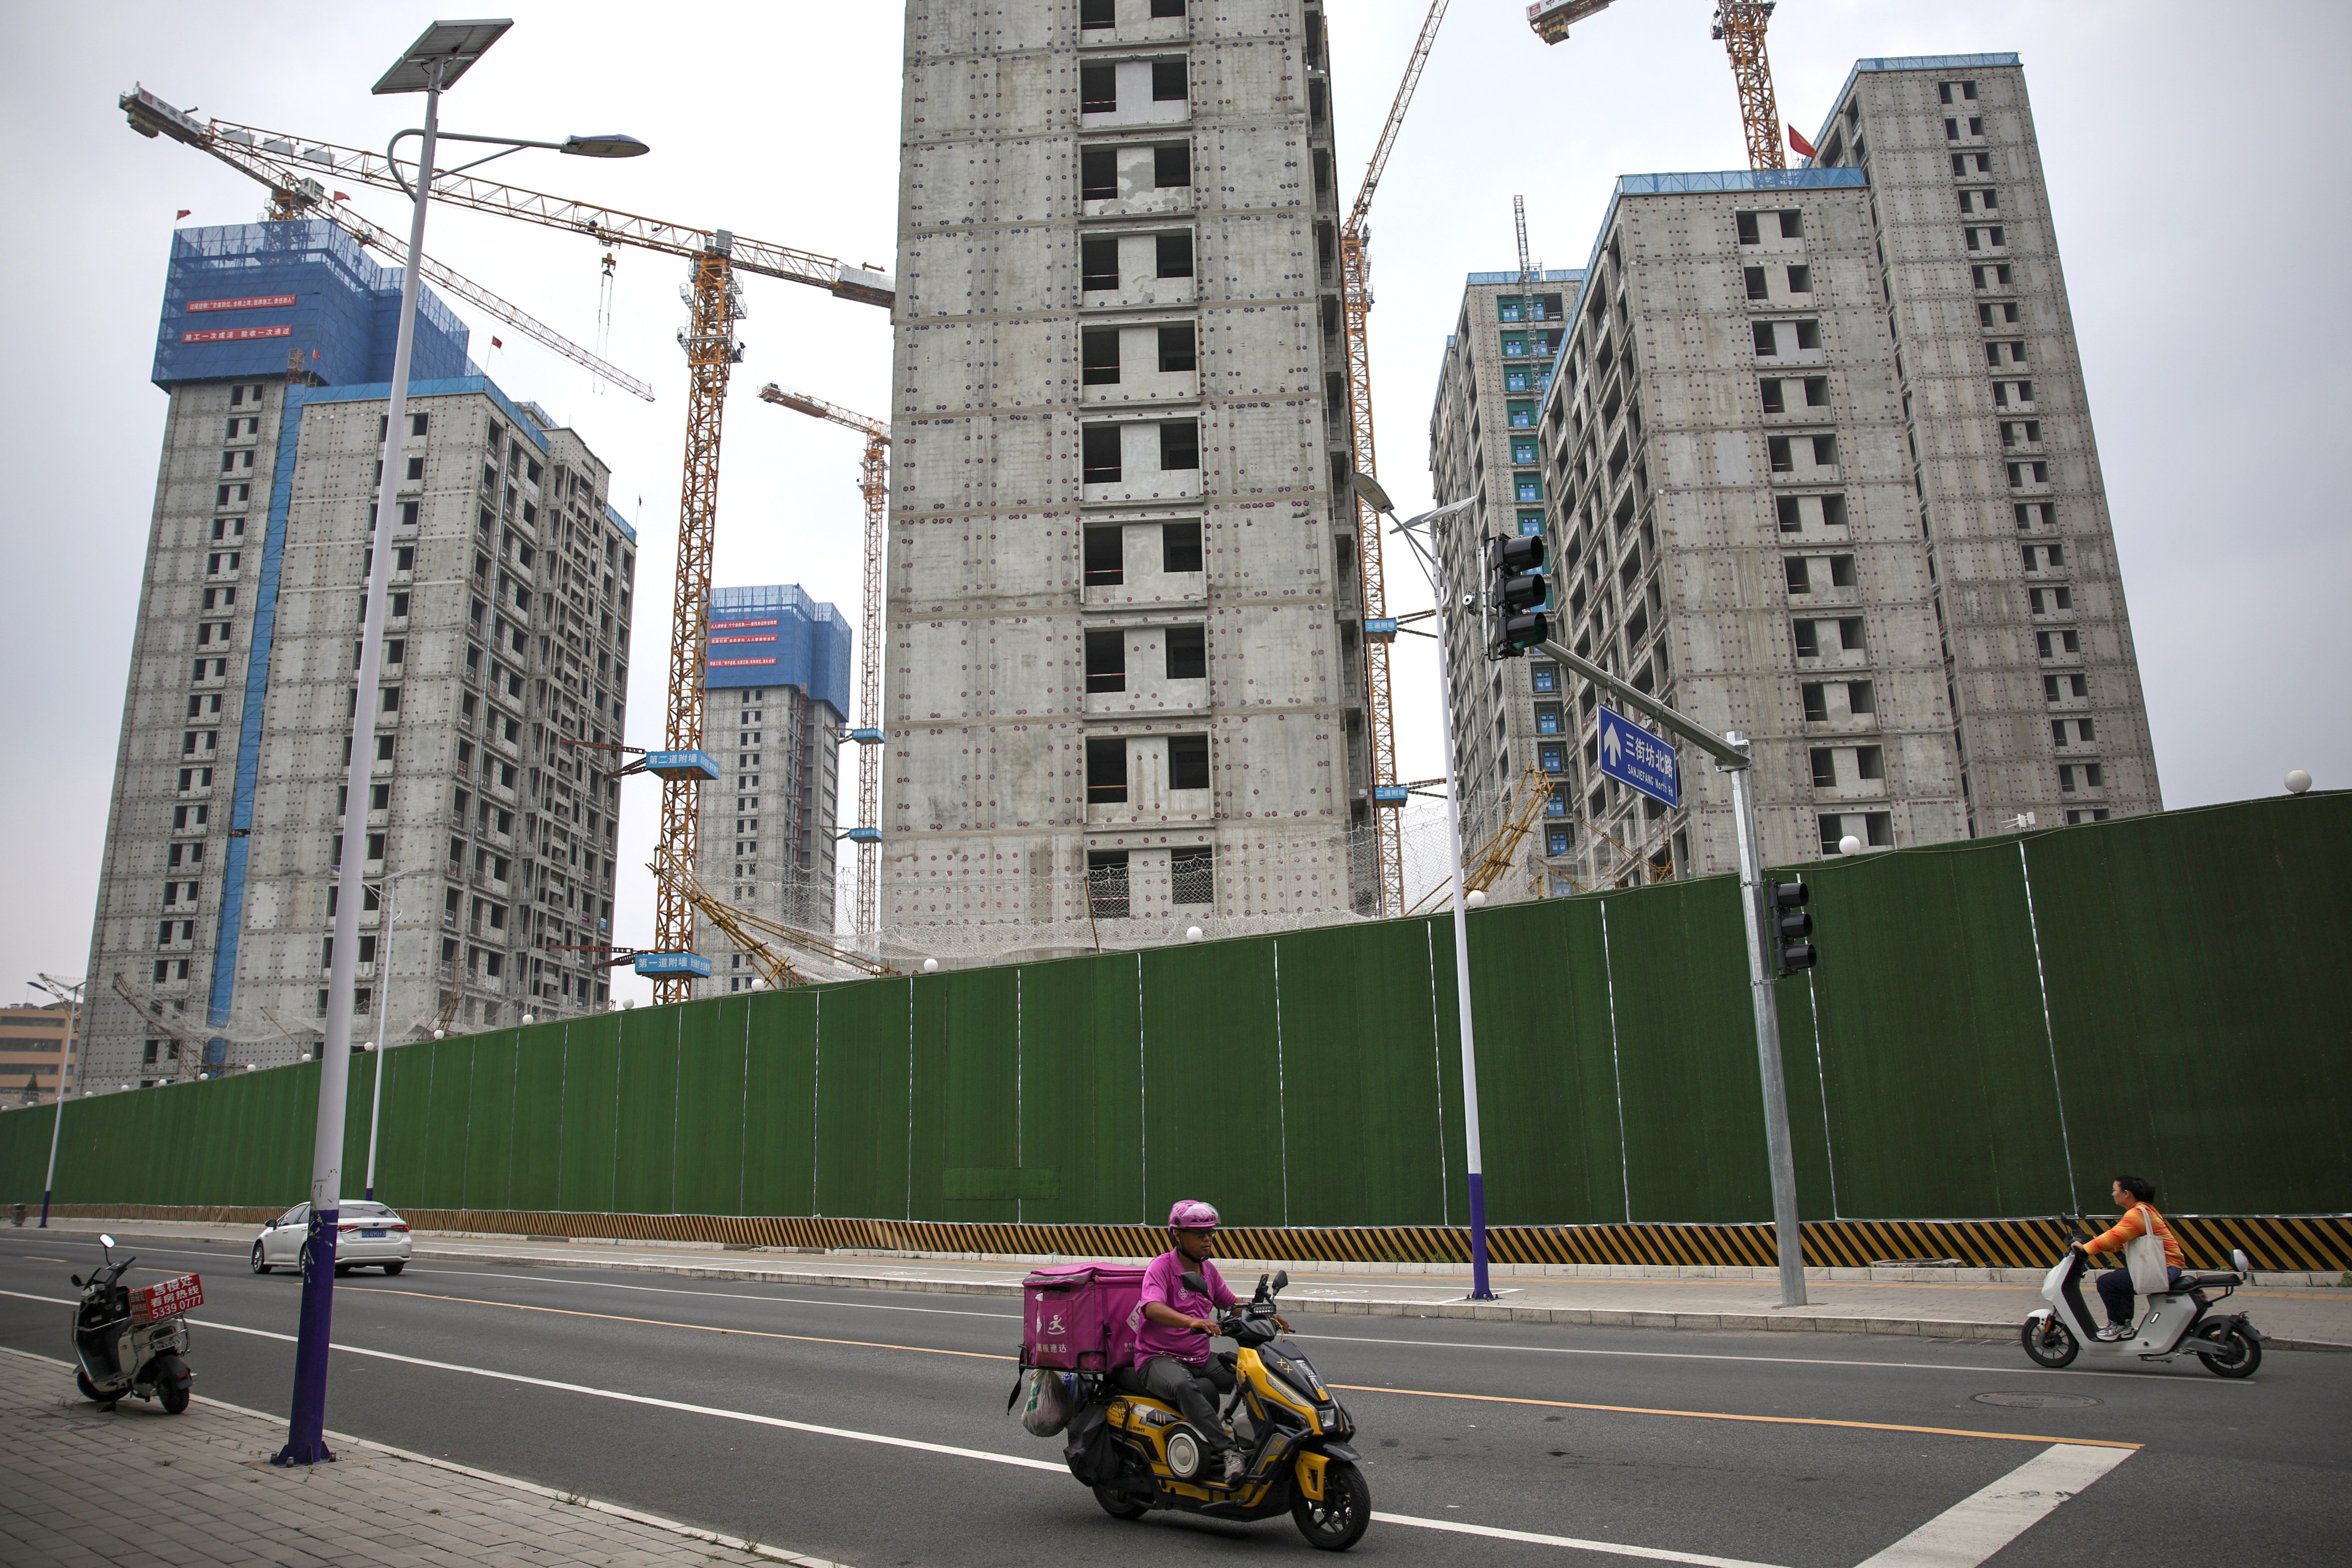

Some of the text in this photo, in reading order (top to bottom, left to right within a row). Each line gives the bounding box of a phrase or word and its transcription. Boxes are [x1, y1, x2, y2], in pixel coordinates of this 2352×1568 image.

[185, 328, 290, 341] 施工一次成活 验收一次通过
[649, 754, 697, 764] 第二道附墙
[1625, 733, 1673, 779] 三街坊北路
[1628, 764, 1673, 797] SANJIEFANG North Rd
[1377, 789, 1405, 797] 二道附墙
[638, 957, 688, 968] 第一道附墙
[153, 1275, 193, 1296] 售楼处
[150, 1285, 199, 1308] 看房热线
[152, 1295, 202, 1319] 5339 0777
